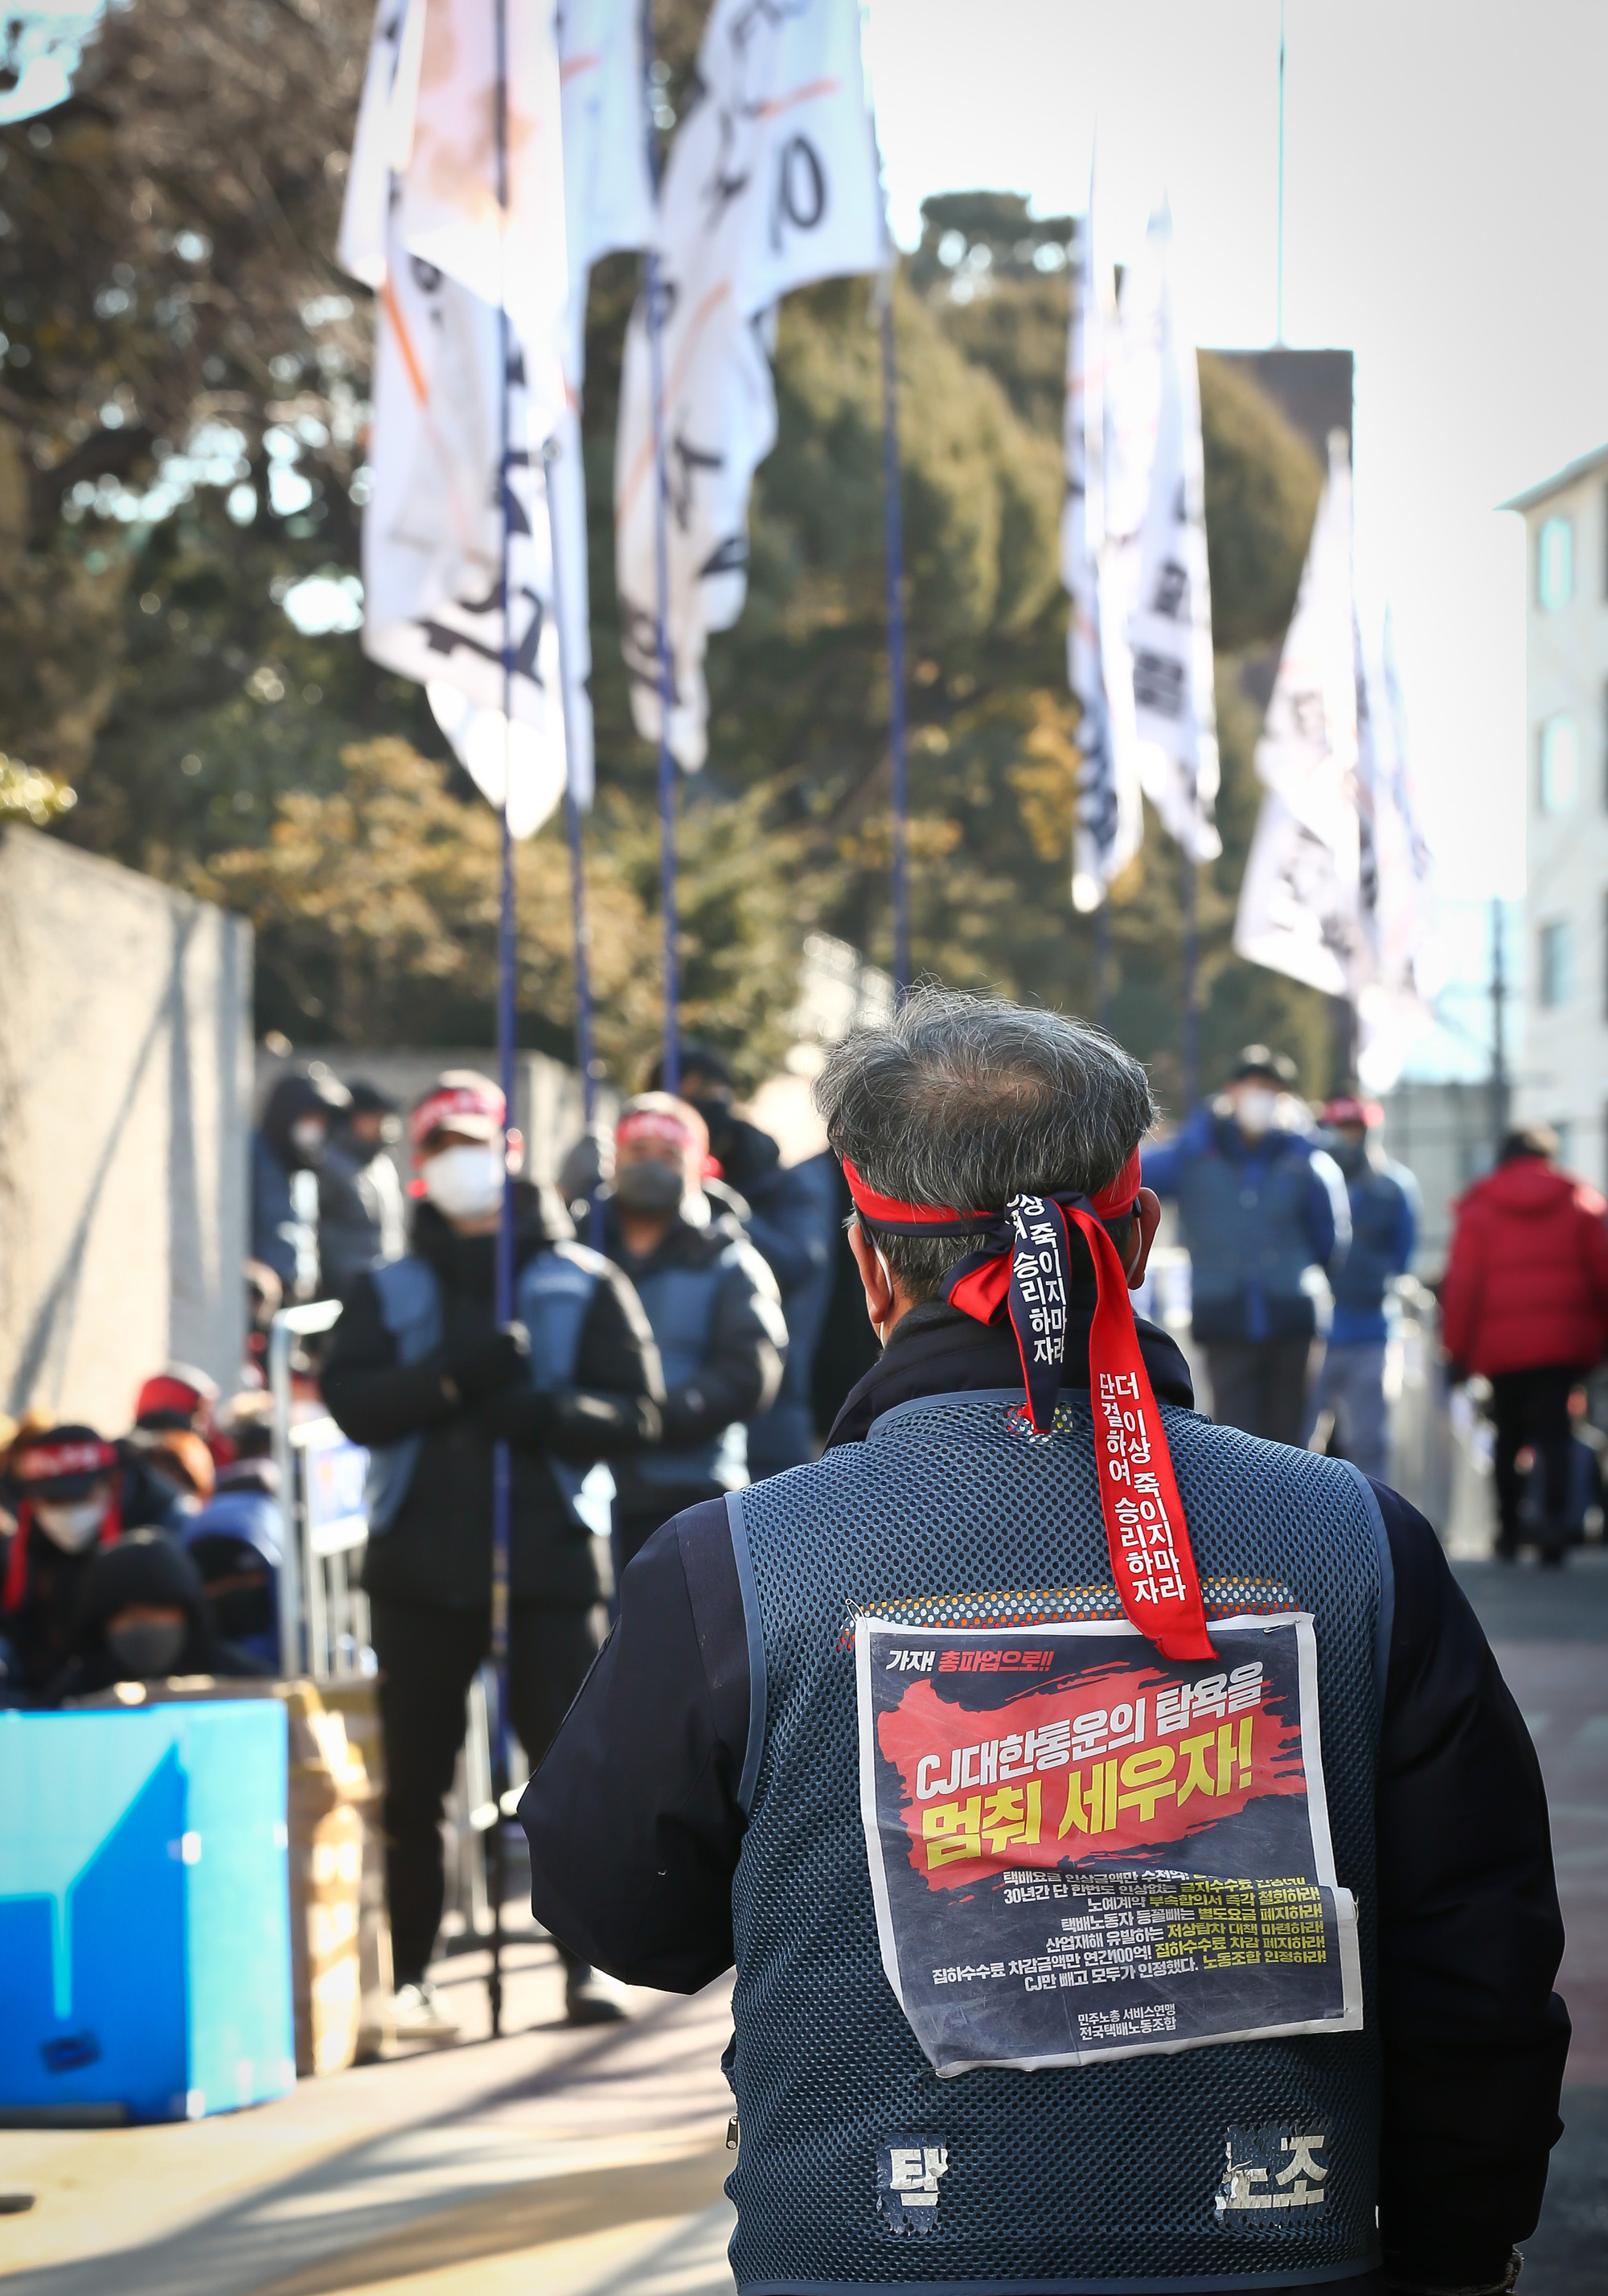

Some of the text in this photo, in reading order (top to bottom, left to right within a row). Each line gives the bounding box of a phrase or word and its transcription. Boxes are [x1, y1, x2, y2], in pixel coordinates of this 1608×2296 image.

[1013, 1251, 1053, 1366] 승리하자
[1029, 1222, 1068, 1364] 죽이지마라
[1098, 1372, 1160, 1605] 단결하여 승리하자
[1114, 1371, 1187, 1602] 더 이상 죽이지마라
[885, 1649, 1055, 1672] 가자! 총파업으로!!
[916, 1661, 1265, 1801] CJ대한통운의 탐욕을
[922, 1715, 1254, 1871] 멈춰 세우자!
[1003, 1871, 1062, 1885] 택배요금
[1003, 1884, 1050, 1904] 30년간
[1052, 1883, 1069, 1899] 단
[1071, 1883, 1116, 1897] 한번도
[1118, 1883, 1177, 1896] 인상없는
[1087, 1886, 1321, 1912] 노예계약 부속합의서 즉각 철회하라!
[1045, 1920, 1324, 1953] 산업재해 유발하는 저상탑차 대책 마련하라!
[1060, 1911, 1134, 1933] 택배노동자
[1198, 1907, 1257, 1921] 별도요금
[1260, 1903, 1323, 1921] 폐지하라!
[932, 1961, 1006, 1985] 집하수수료
[1007, 1953, 1081, 1976] 차감금액만
[1155, 1937, 1227, 1959] 집하수수료
[1230, 1937, 1260, 1949] 차감
[1263, 1935, 1326, 1949] 폐지하라!
[1024, 1950, 1327, 1992] CJ만 빼고 모두가 인정했다. 노동조합 인정하라!
[1077, 2003, 1176, 2027] 민주노총 서비스연맹
[1079, 2016, 1177, 2041] 전국택배노동조합
